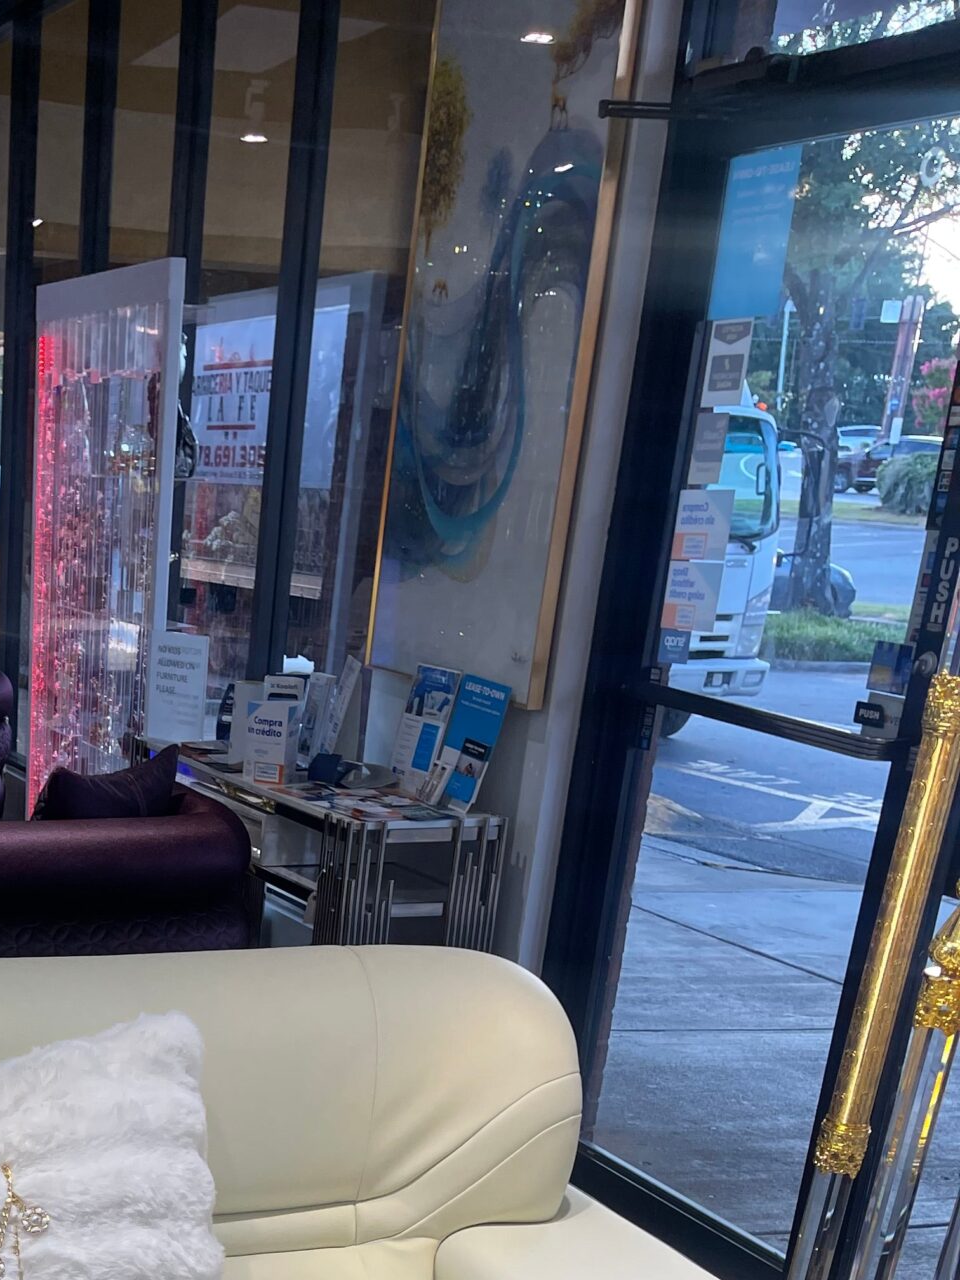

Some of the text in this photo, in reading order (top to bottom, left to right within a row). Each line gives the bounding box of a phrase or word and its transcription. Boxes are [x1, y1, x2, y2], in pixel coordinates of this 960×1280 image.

[207, 395, 257, 422] LA FE
[929, 537, 960, 623] PUSH
[859, 708, 880, 720] PUSH
[253, 715, 283, 728] Compra
[255, 727, 282, 738] crédito
